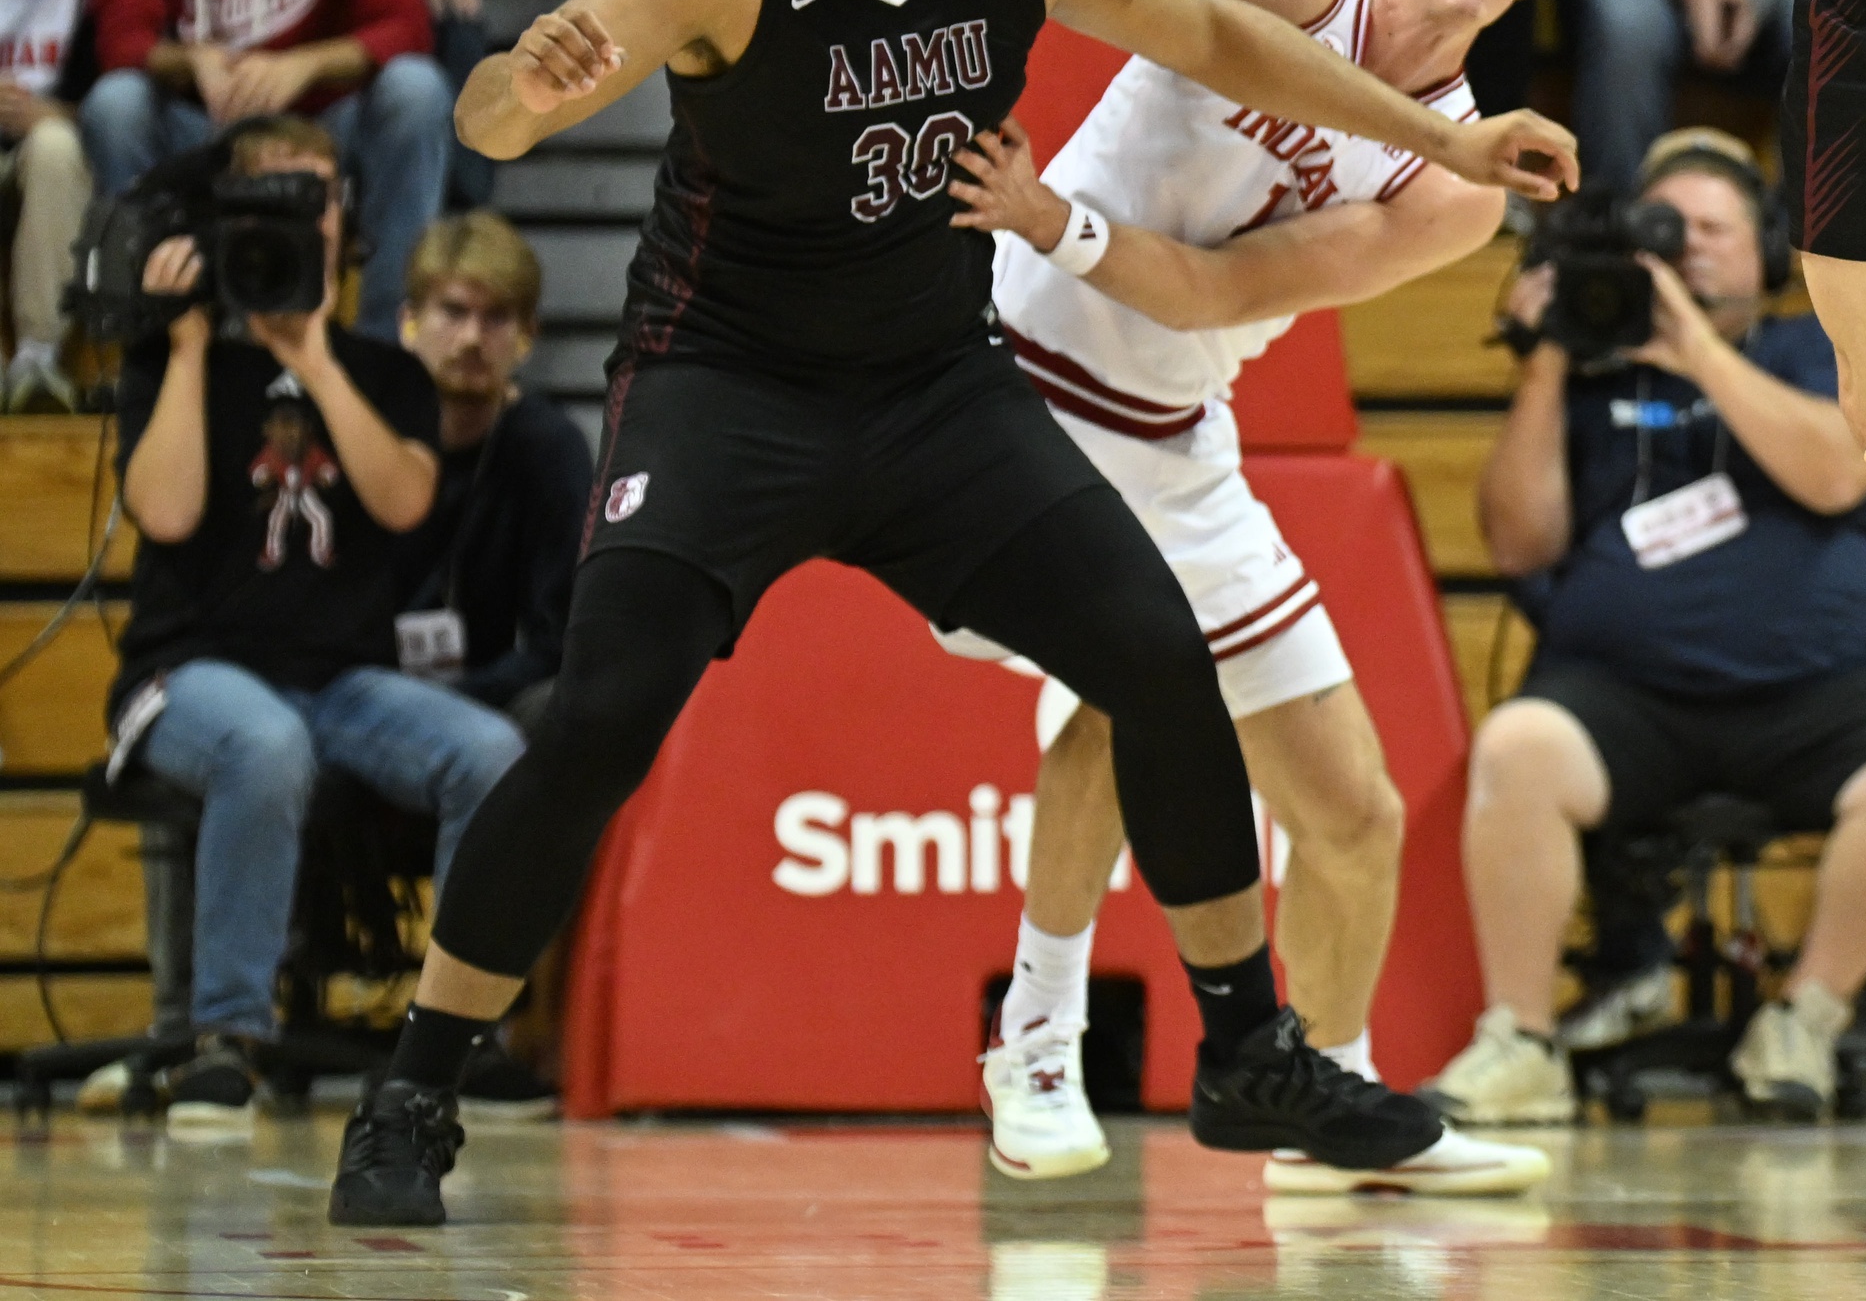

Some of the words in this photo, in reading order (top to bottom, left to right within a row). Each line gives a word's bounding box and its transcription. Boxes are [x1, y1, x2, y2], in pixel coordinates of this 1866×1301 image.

[824, 18, 993, 113] AAMU
[851, 110, 975, 224] 30
[772, 783, 1038, 896] Smit
